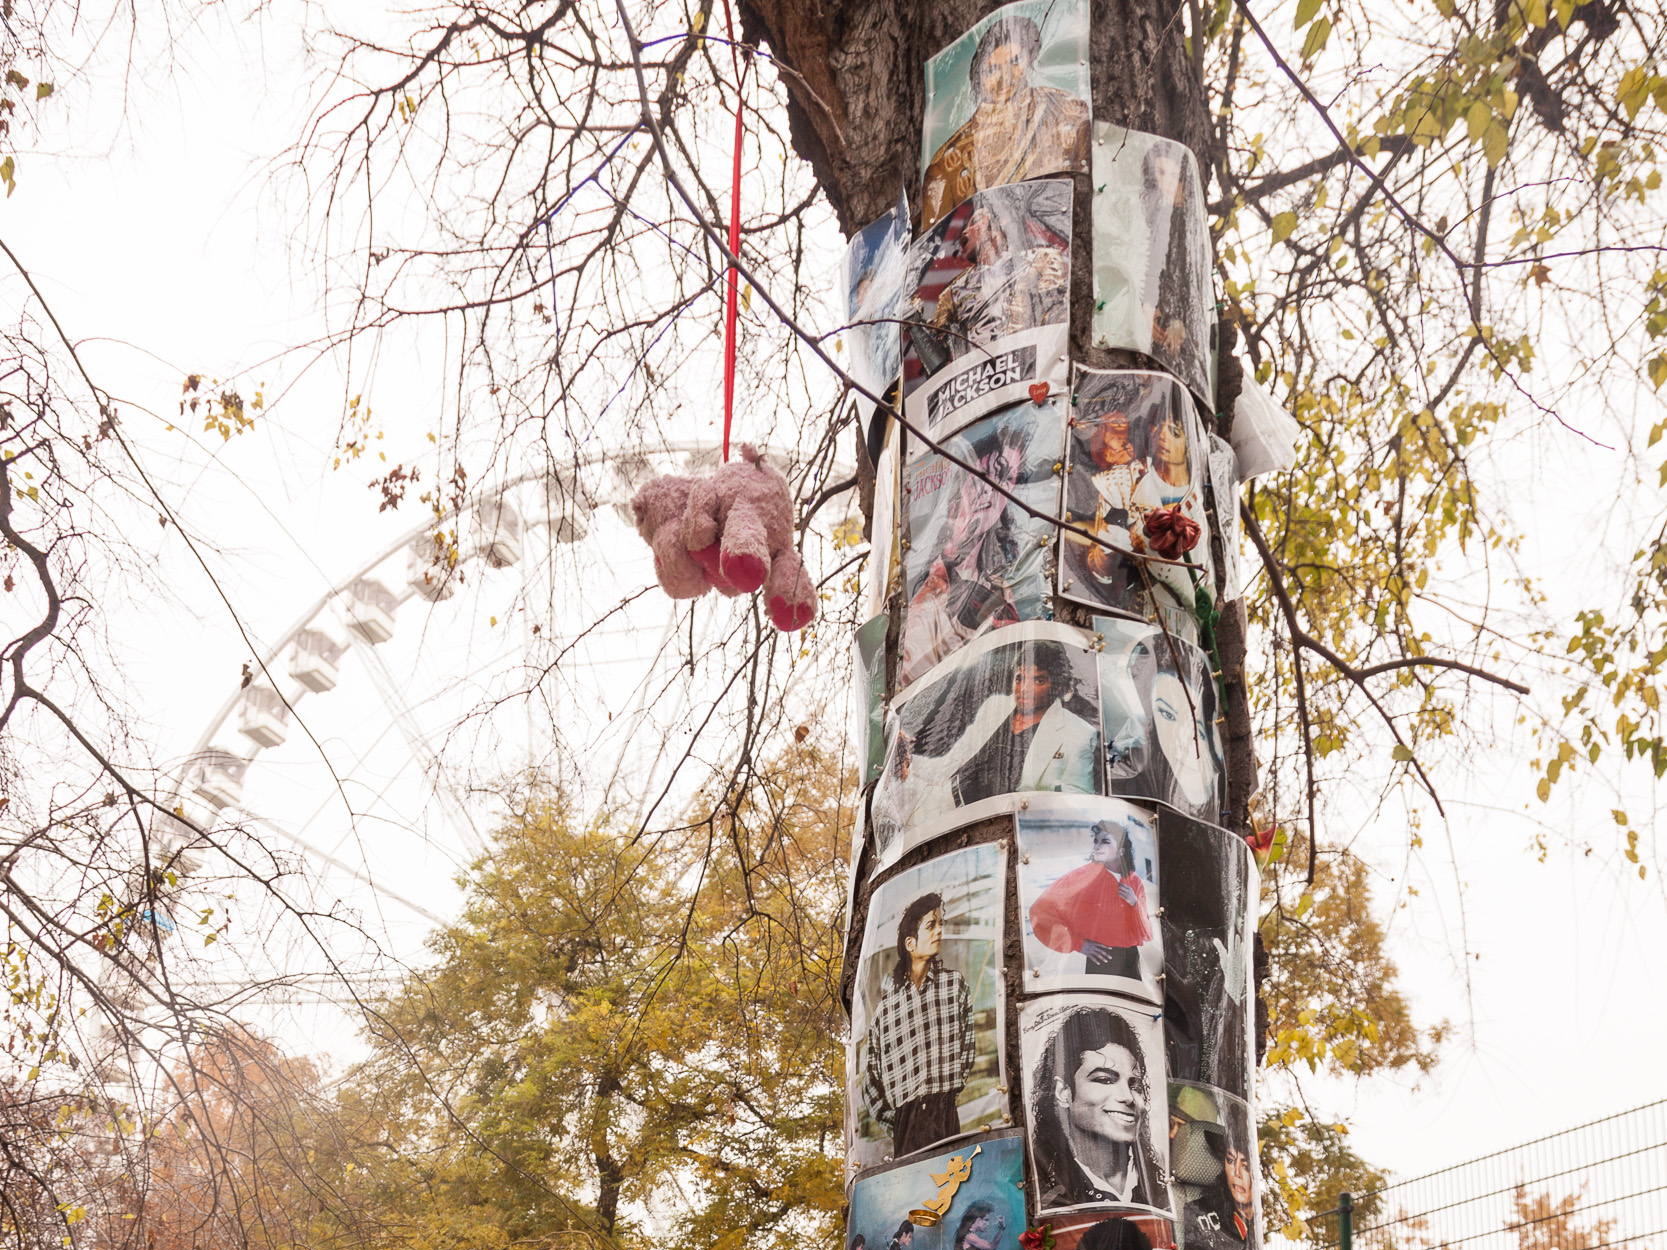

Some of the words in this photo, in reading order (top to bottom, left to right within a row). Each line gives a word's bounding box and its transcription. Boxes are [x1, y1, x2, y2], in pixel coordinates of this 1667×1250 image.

[934, 367, 1021, 424] JACKSON
[938, 354, 1019, 406] MICHAEL
[913, 468, 953, 501] JACKSON
